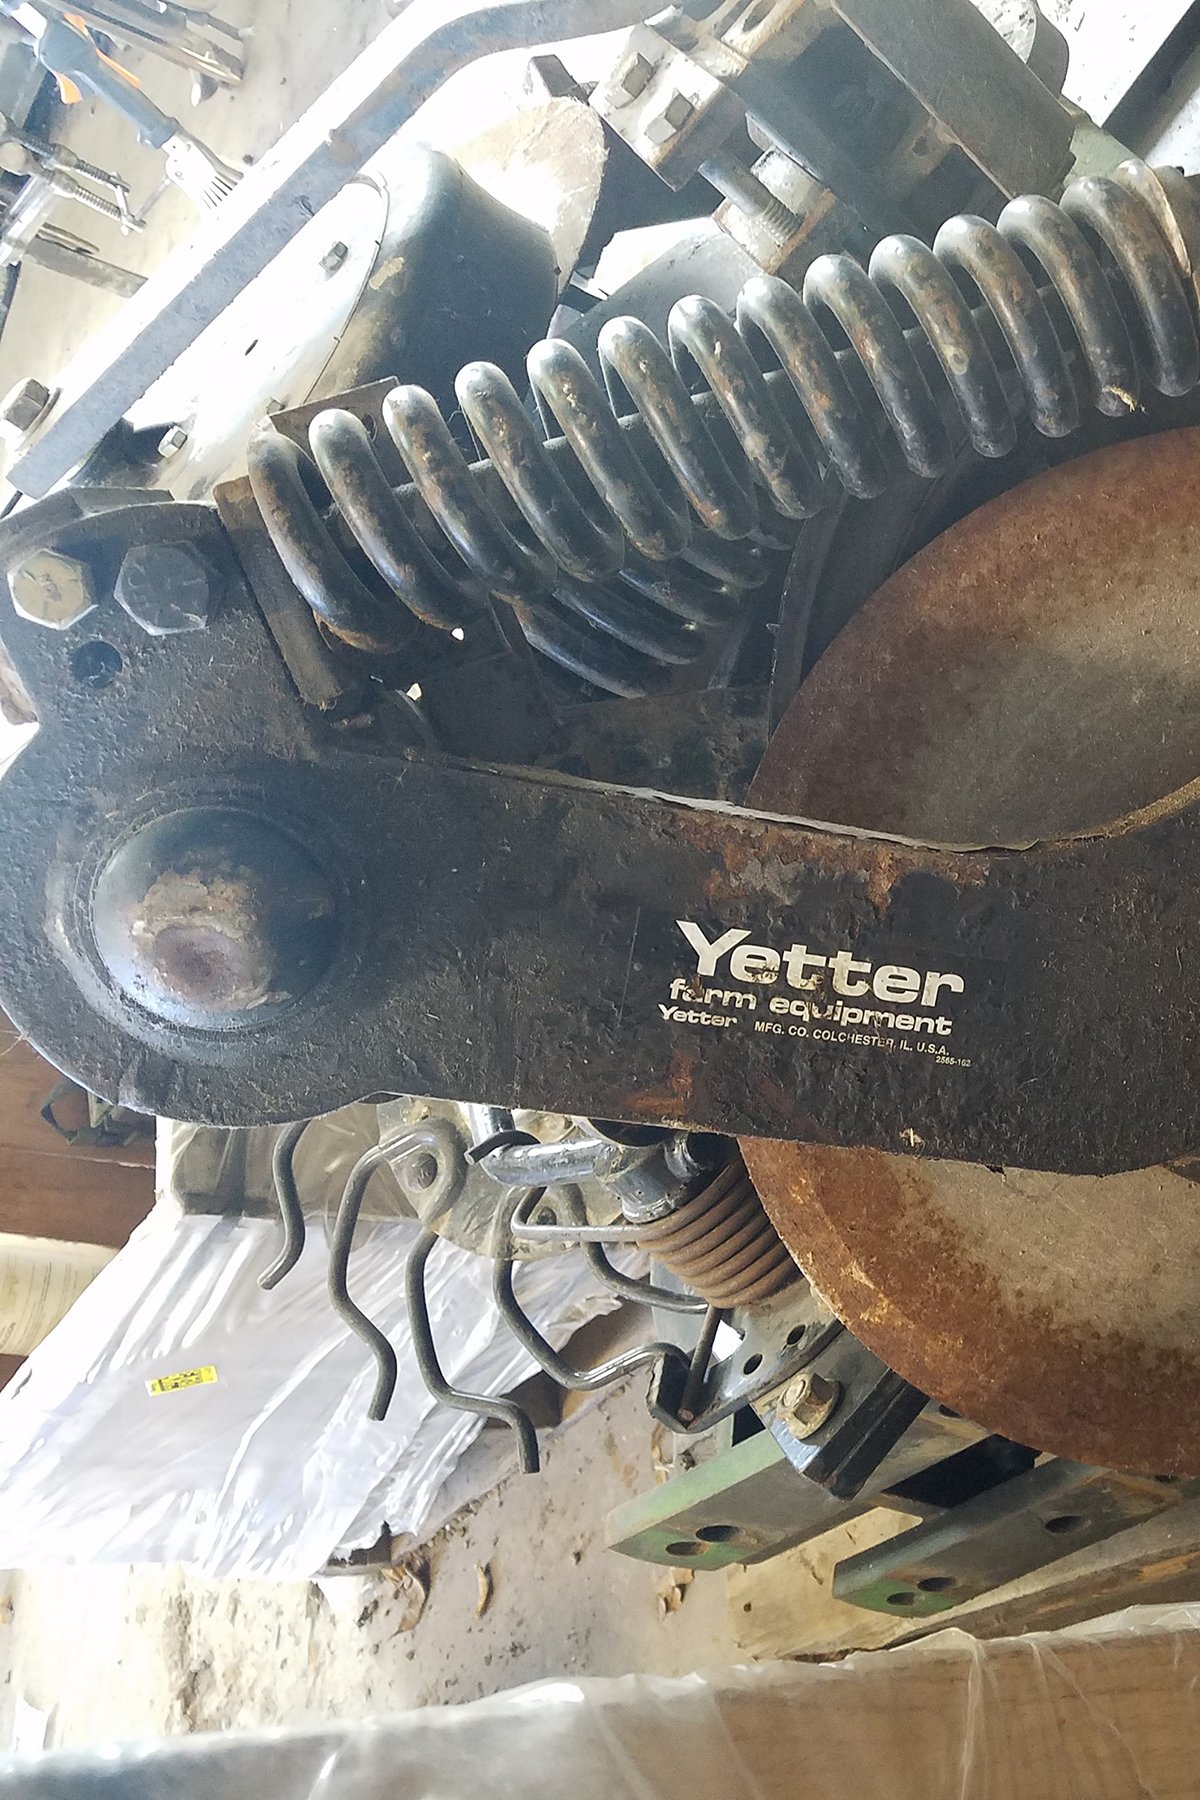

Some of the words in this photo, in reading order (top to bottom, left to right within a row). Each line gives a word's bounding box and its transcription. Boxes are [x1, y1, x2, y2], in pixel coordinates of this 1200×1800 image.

[675, 919, 965, 1008] Yetter
[658, 1003, 738, 1028] Yetter
[754, 1021, 785, 1035] MFG.
[788, 1025, 809, 1038] CO.
[899, 1040, 914, 1051] IL.
[916, 1042, 950, 1056] U.S.A.
[669, 978, 757, 1010] farm
[769, 997, 953, 1036] equipment
